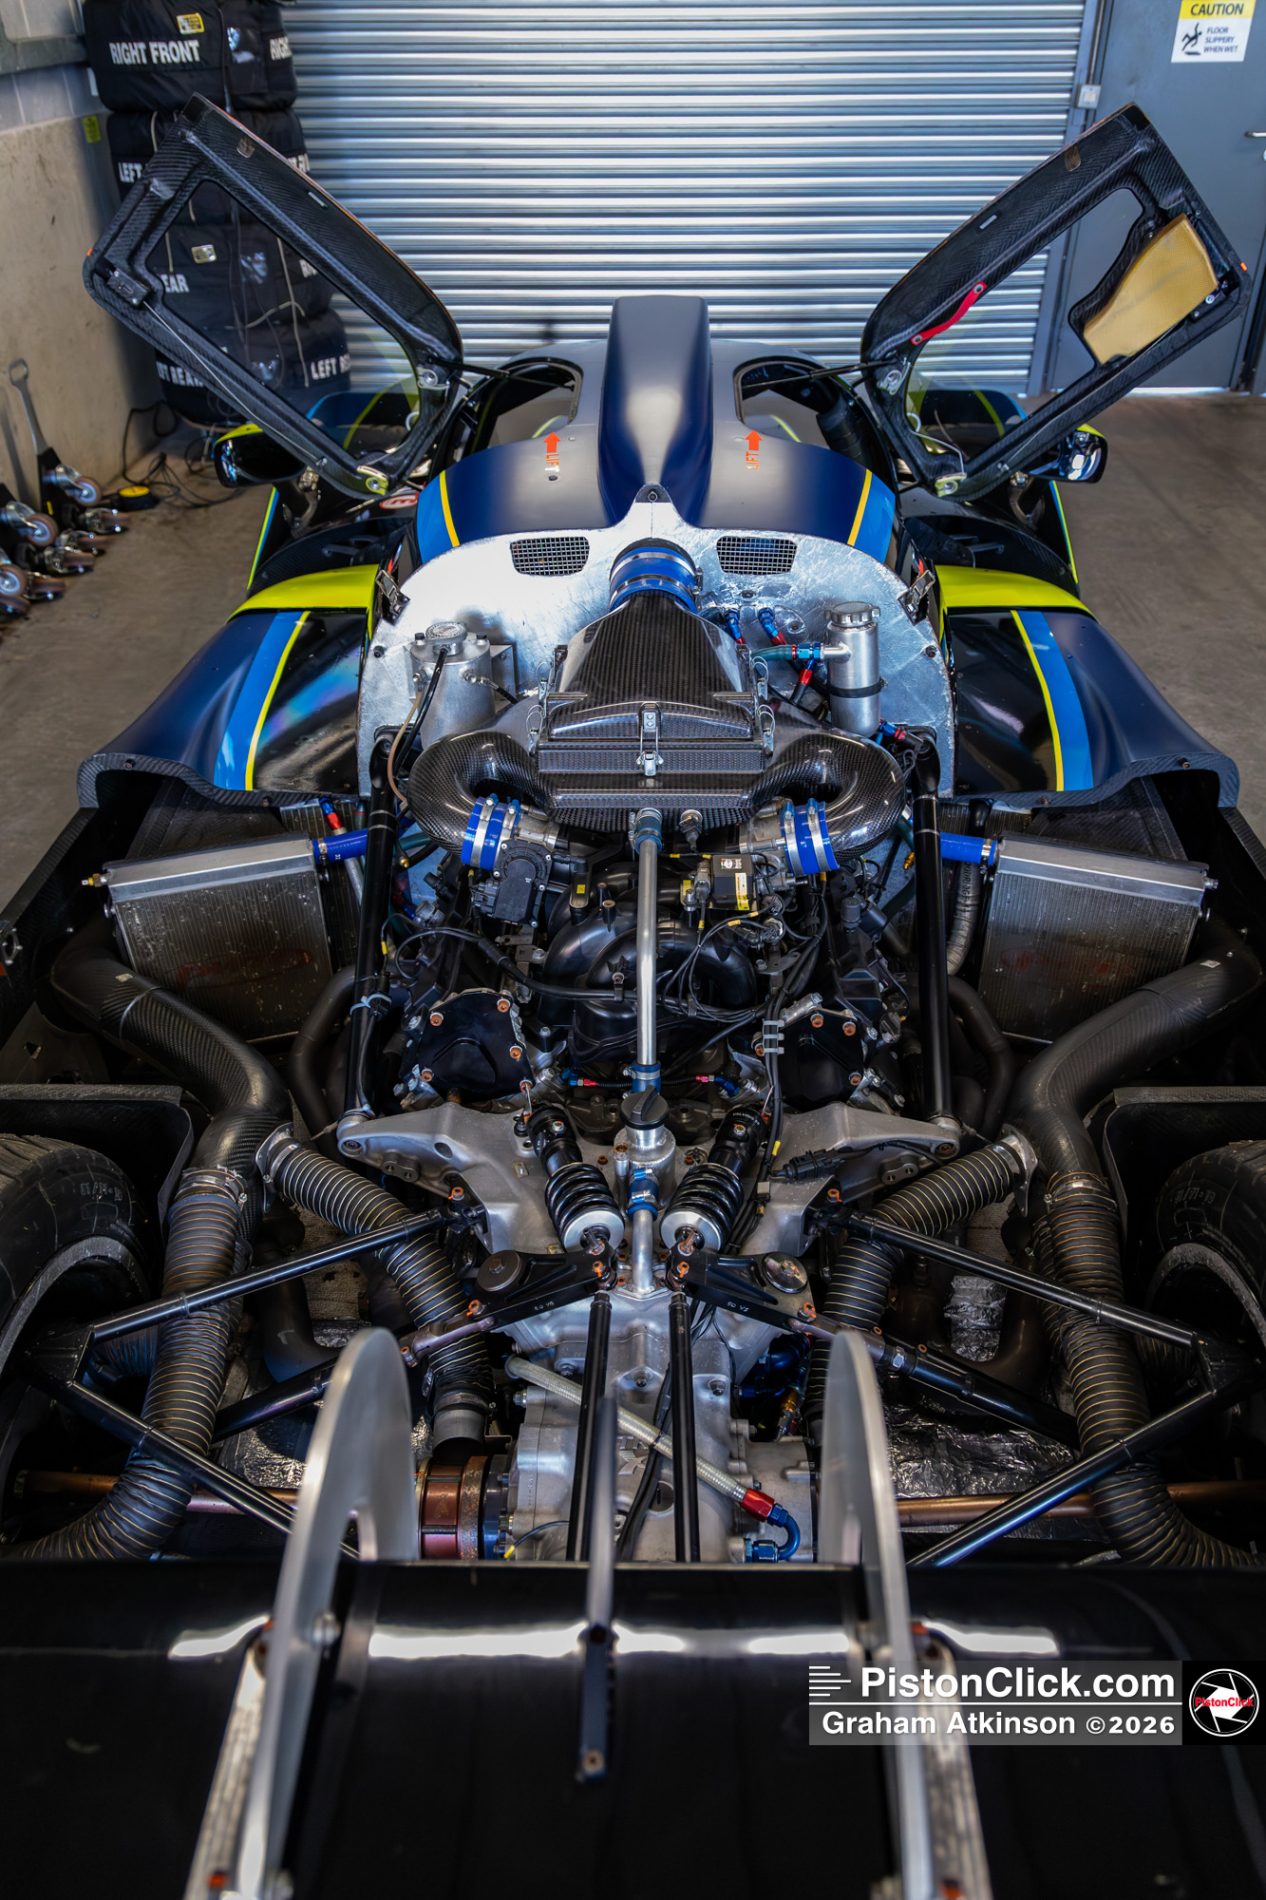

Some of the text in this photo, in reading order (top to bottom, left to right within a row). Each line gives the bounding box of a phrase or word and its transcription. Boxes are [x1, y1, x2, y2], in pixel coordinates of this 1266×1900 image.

[1190, 3, 1244, 16] CAUTION
[1205, 36, 1235, 44] SLIPPERY
[1207, 27, 1229, 35] FLOOR
[109, 40, 200, 65] RIGHT FRONT
[118, 162, 143, 183] LEFT
[160, 273, 190, 293] EAR
[310, 357, 337, 380] LEFT
